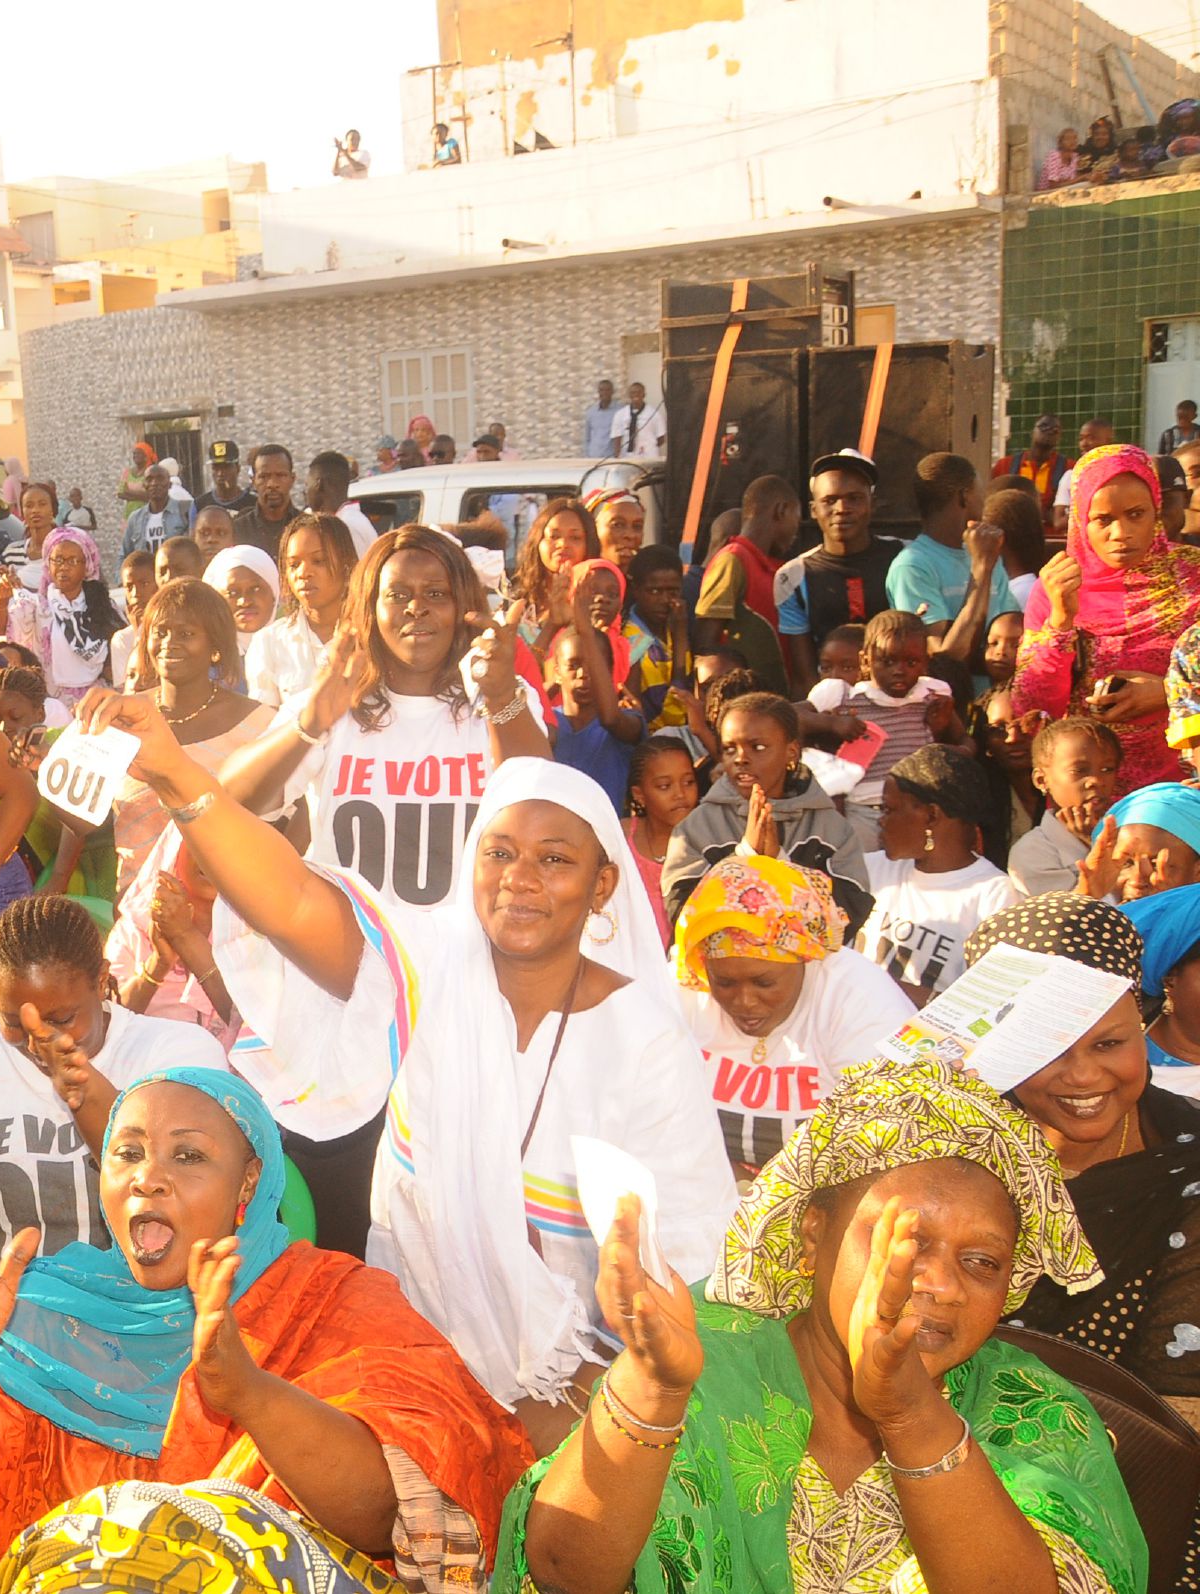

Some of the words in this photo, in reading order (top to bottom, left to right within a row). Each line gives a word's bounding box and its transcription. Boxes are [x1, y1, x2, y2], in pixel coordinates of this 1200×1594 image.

[47, 758, 106, 814] OUI
[333, 755, 375, 796] JE
[385, 753, 486, 797] VOTE
[887, 1036, 911, 1054] VOTE
[712, 1056, 820, 1112] VOTE
